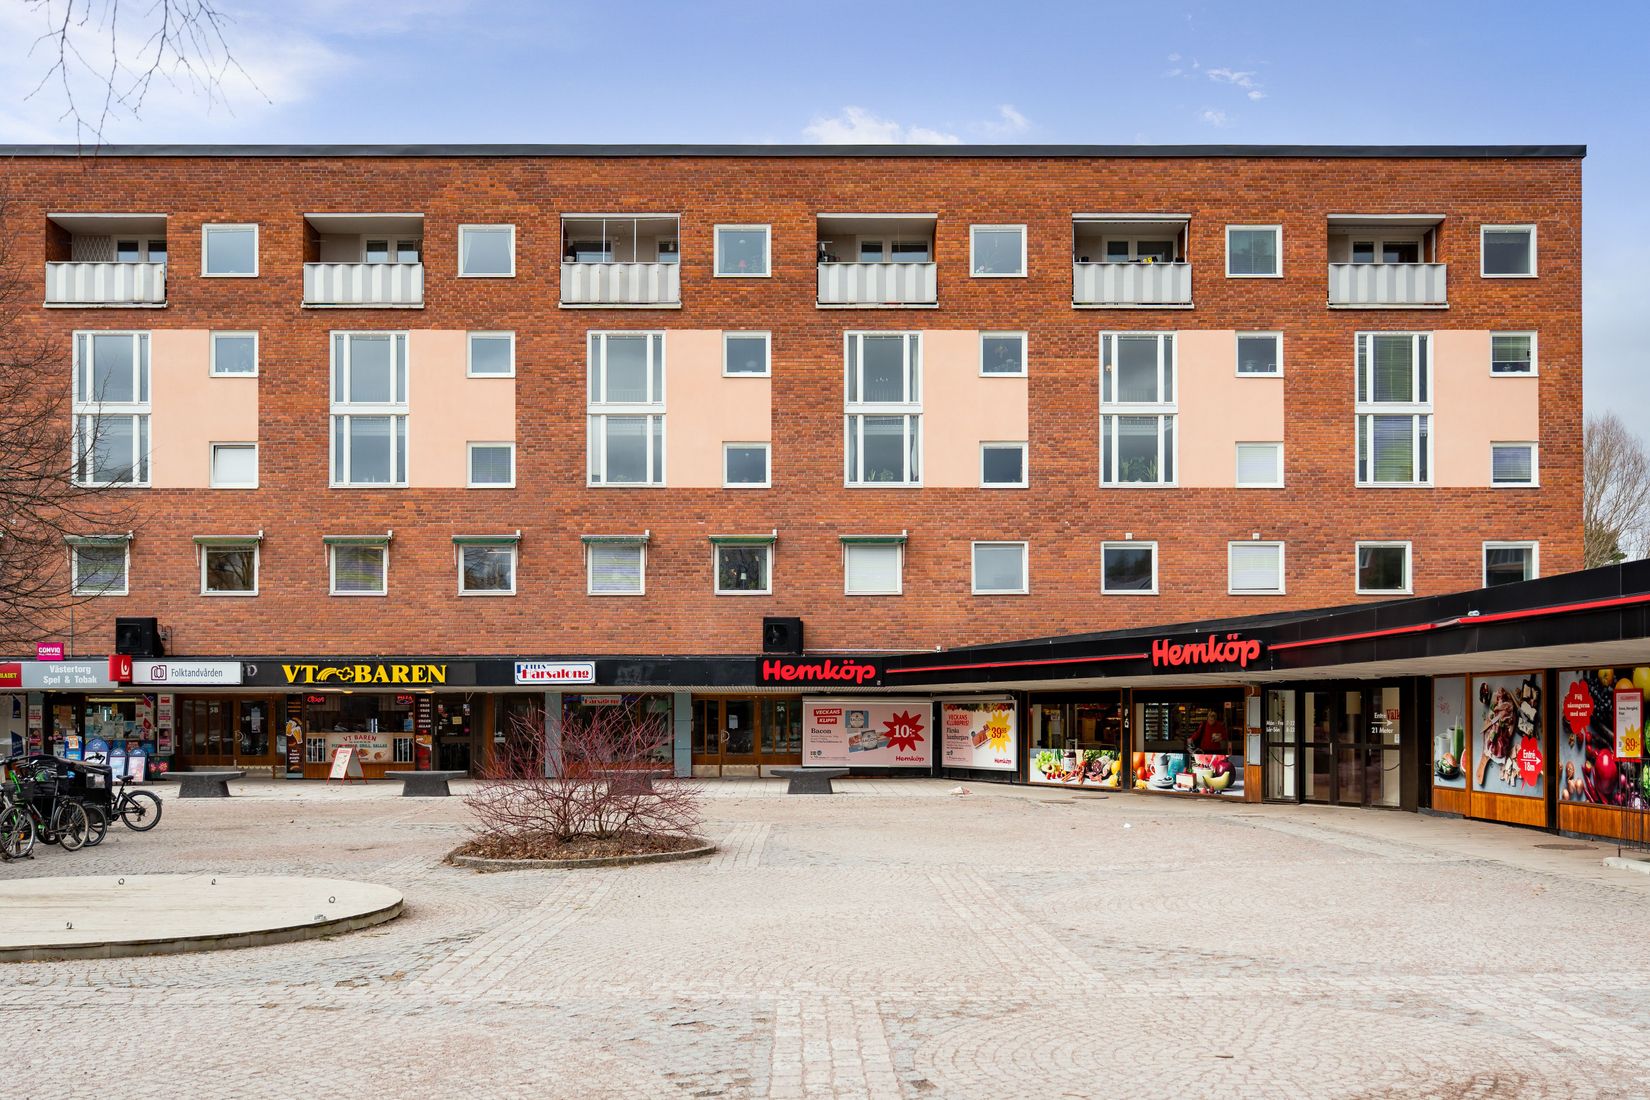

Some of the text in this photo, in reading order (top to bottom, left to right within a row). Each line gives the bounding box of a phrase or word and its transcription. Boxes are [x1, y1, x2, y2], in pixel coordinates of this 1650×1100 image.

[1152, 633, 1261, 667] Hemköp
[49, 665, 91, 674] Västertorg
[171, 668, 223, 678] Folktandvården
[282, 664, 447, 684] VT BAREN
[763, 659, 876, 684] Hemköp
[43, 675, 97, 685] Spel & Tobak
[895, 755, 925, 763] Hemköp
